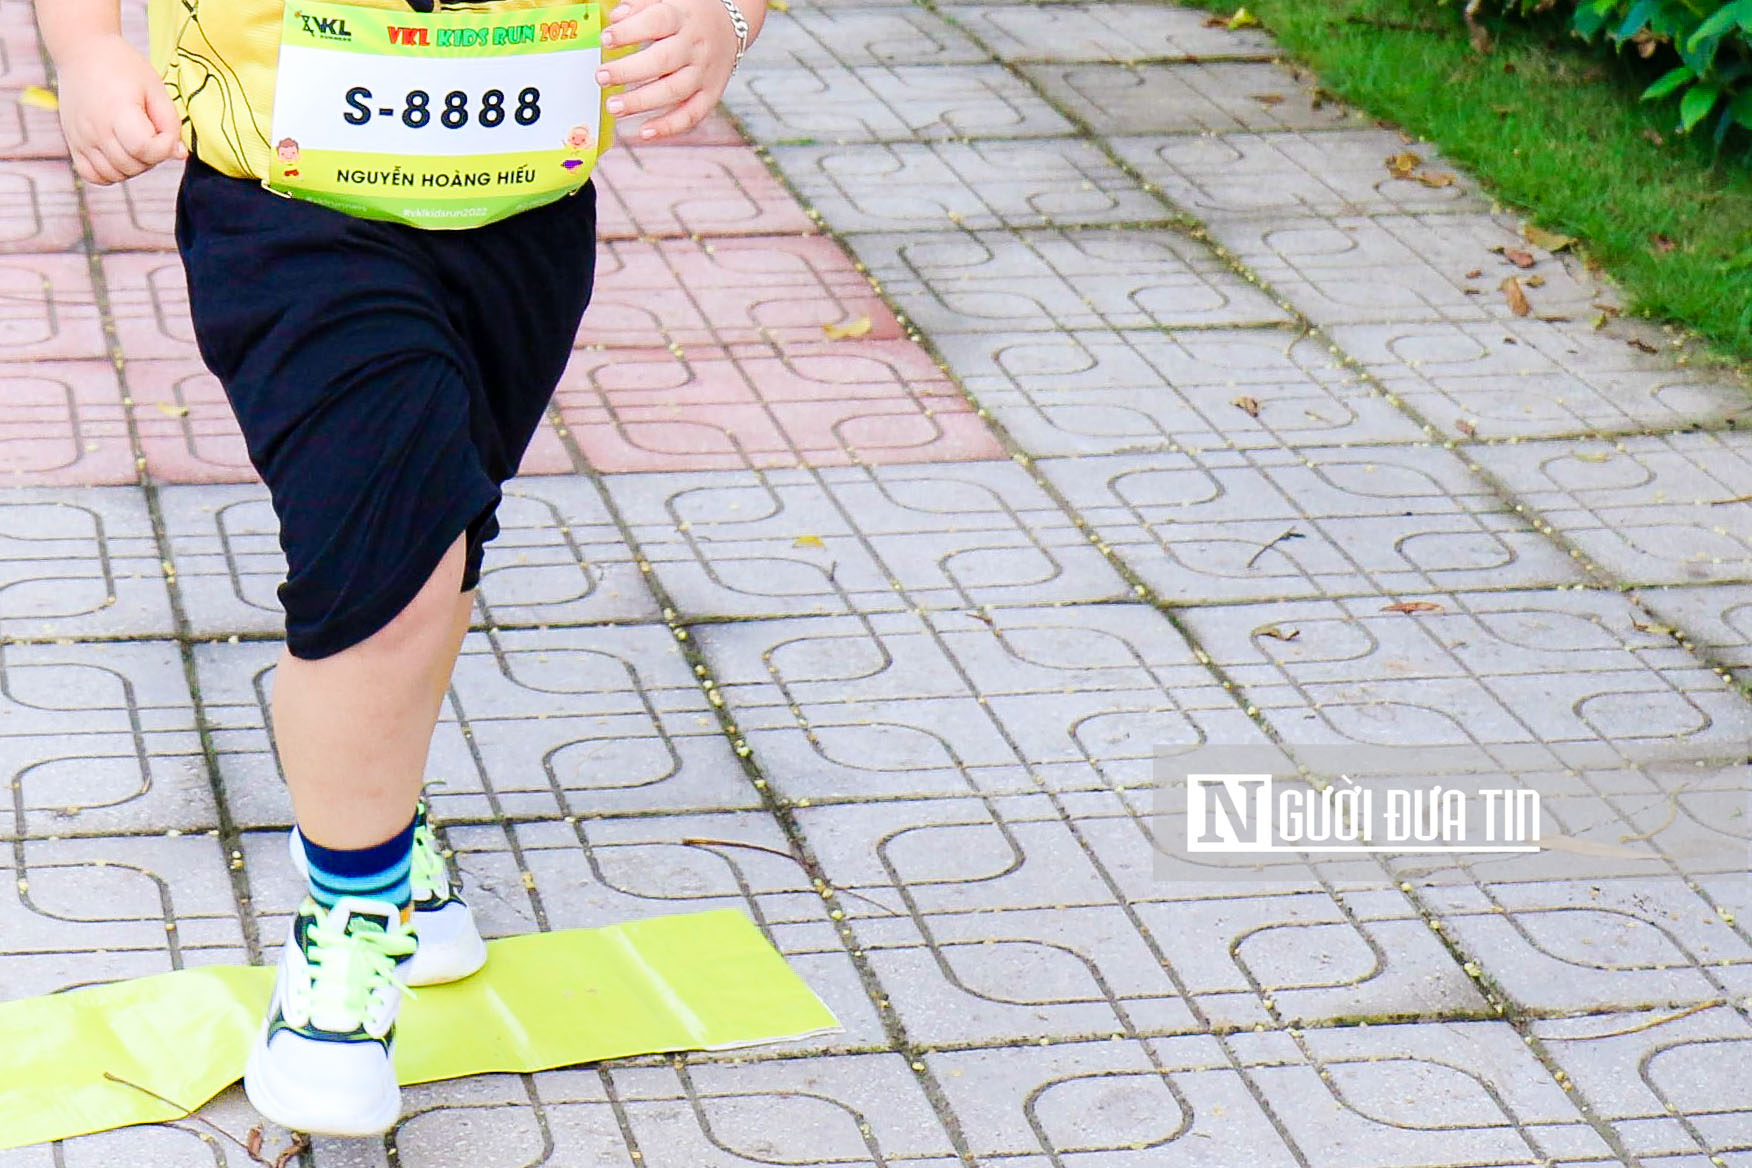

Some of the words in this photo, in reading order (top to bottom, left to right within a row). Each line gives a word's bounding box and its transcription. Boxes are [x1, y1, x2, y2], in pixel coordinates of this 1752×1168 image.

[312, 16, 351, 36] VKL
[387, 26, 430, 46] VKL
[436, 27, 489, 47] KIDS
[492, 24, 535, 45] RUN
[539, 19, 578, 42] 2022
[343, 86, 541, 129] S-8888
[336, 165, 414, 187] NGUYỄN
[422, 170, 491, 187] HOÀNG
[497, 164, 536, 185] HIẾU
